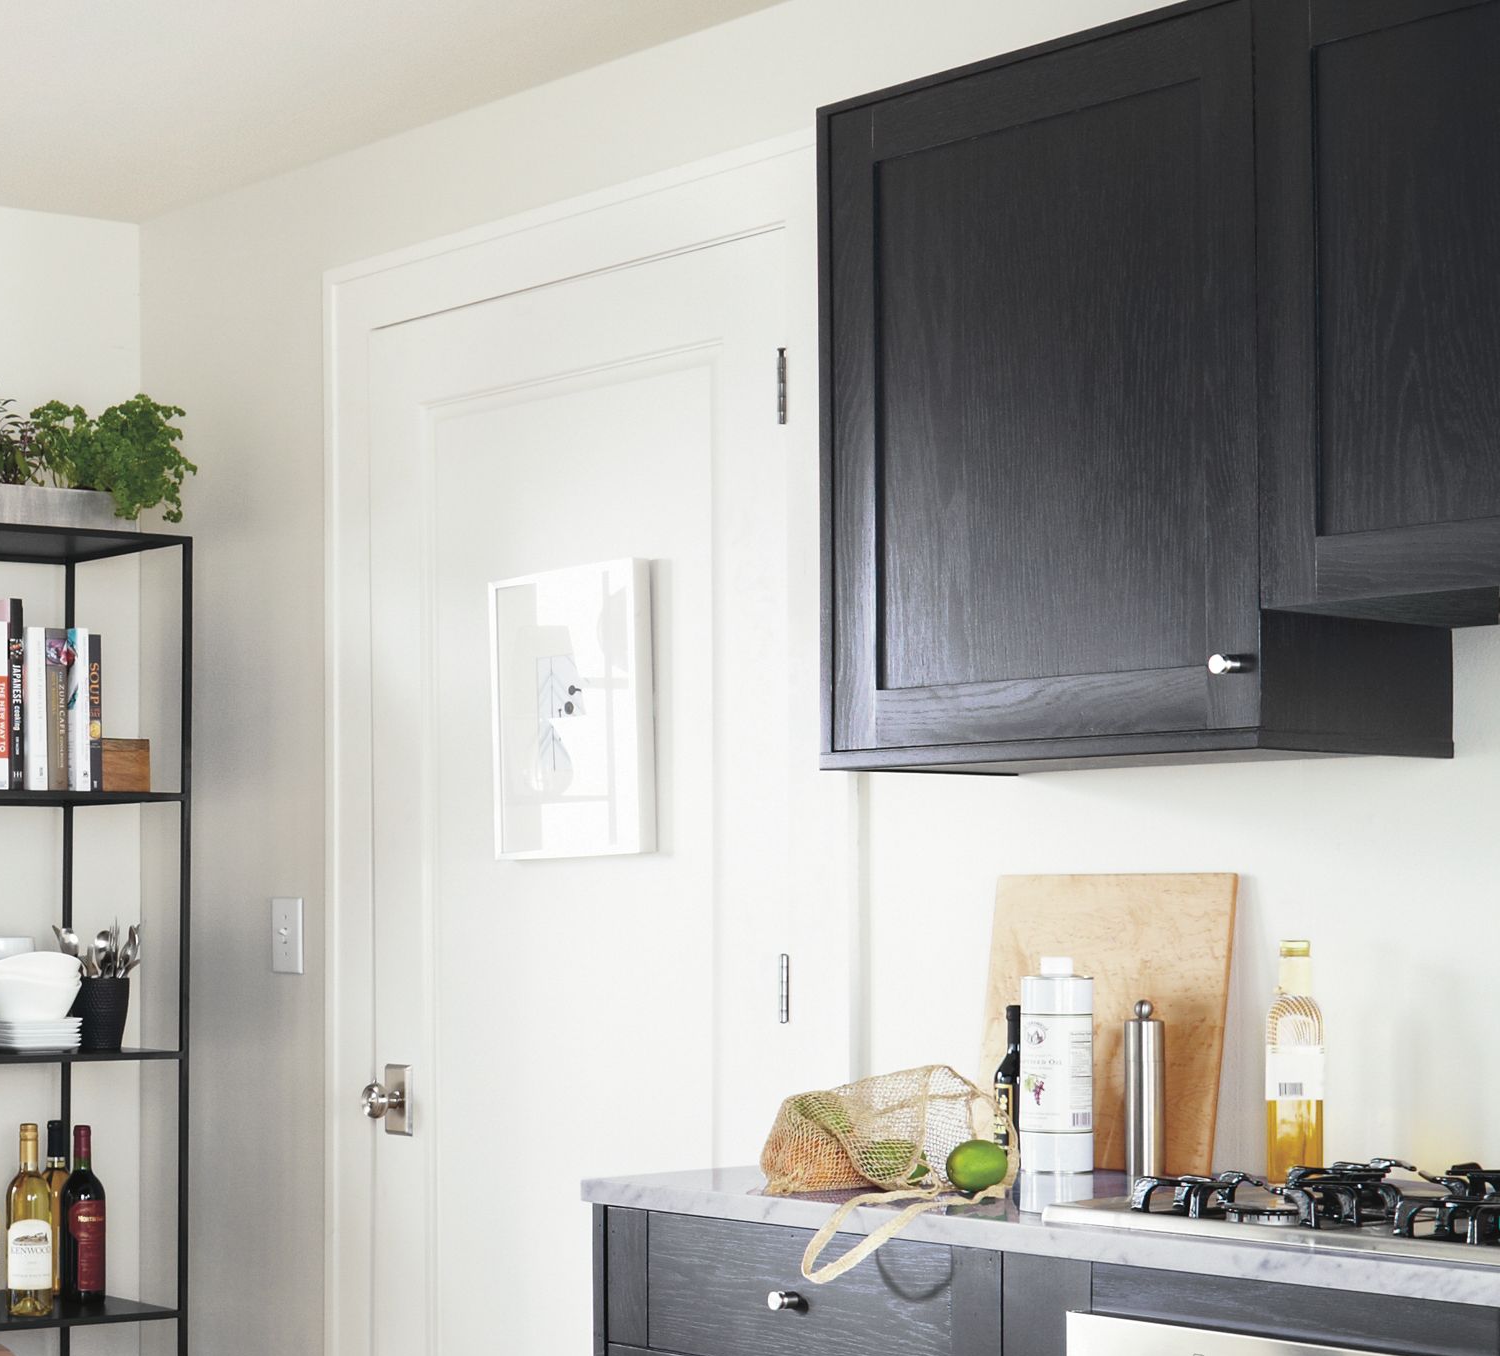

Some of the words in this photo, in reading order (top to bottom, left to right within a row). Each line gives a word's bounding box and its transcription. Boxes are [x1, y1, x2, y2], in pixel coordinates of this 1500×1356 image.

[12, 664, 22, 704] JAPANESE
[89, 662, 100, 704] SOUP
[12, 705, 21, 731] cooking
[0, 741, 6, 753] TO
